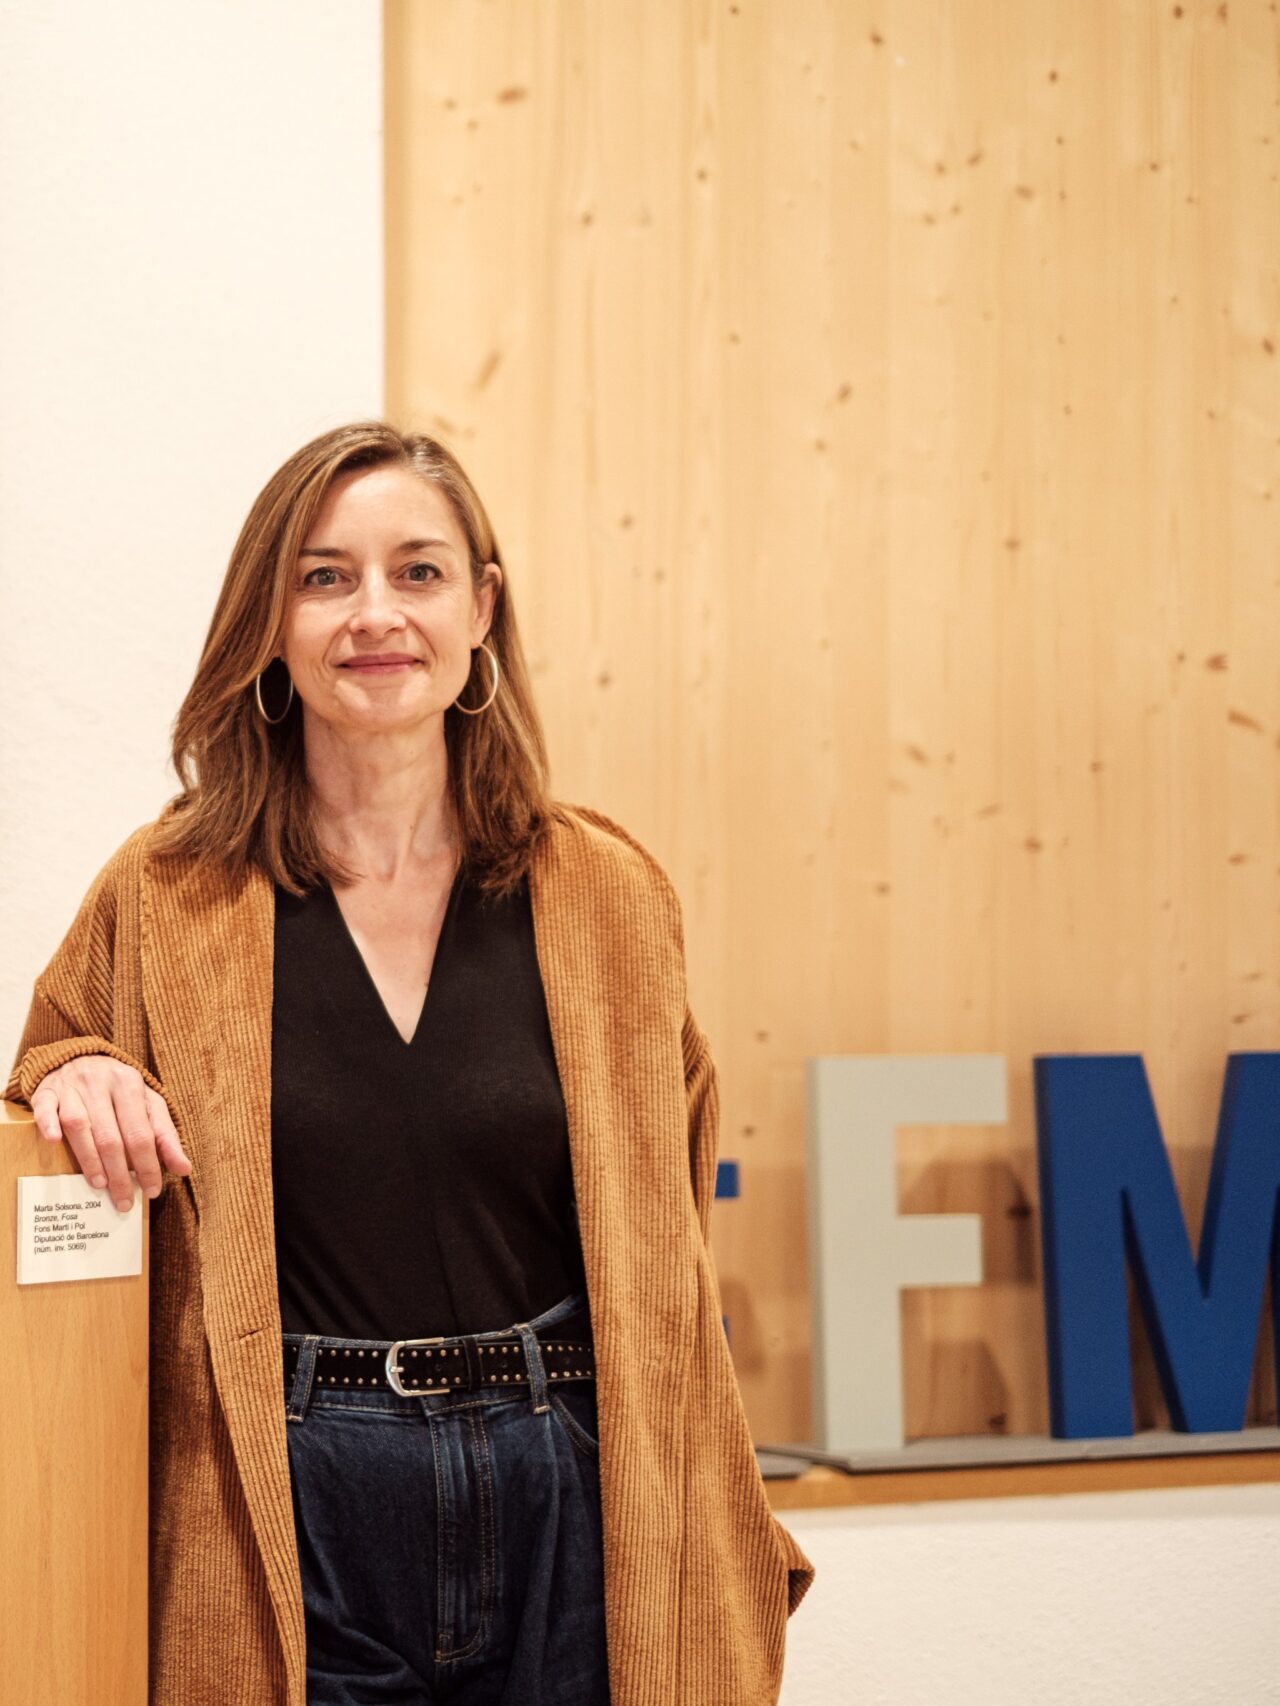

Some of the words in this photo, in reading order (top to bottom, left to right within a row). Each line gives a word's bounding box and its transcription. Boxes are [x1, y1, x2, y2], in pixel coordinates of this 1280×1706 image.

[85, 1201, 101, 1209] 2004
[34, 1225, 51, 1233] Fons
[74, 1222, 85, 1230] Pol
[34, 1234, 64, 1243] Diputació
[76, 1231, 109, 1240] Barcelona
